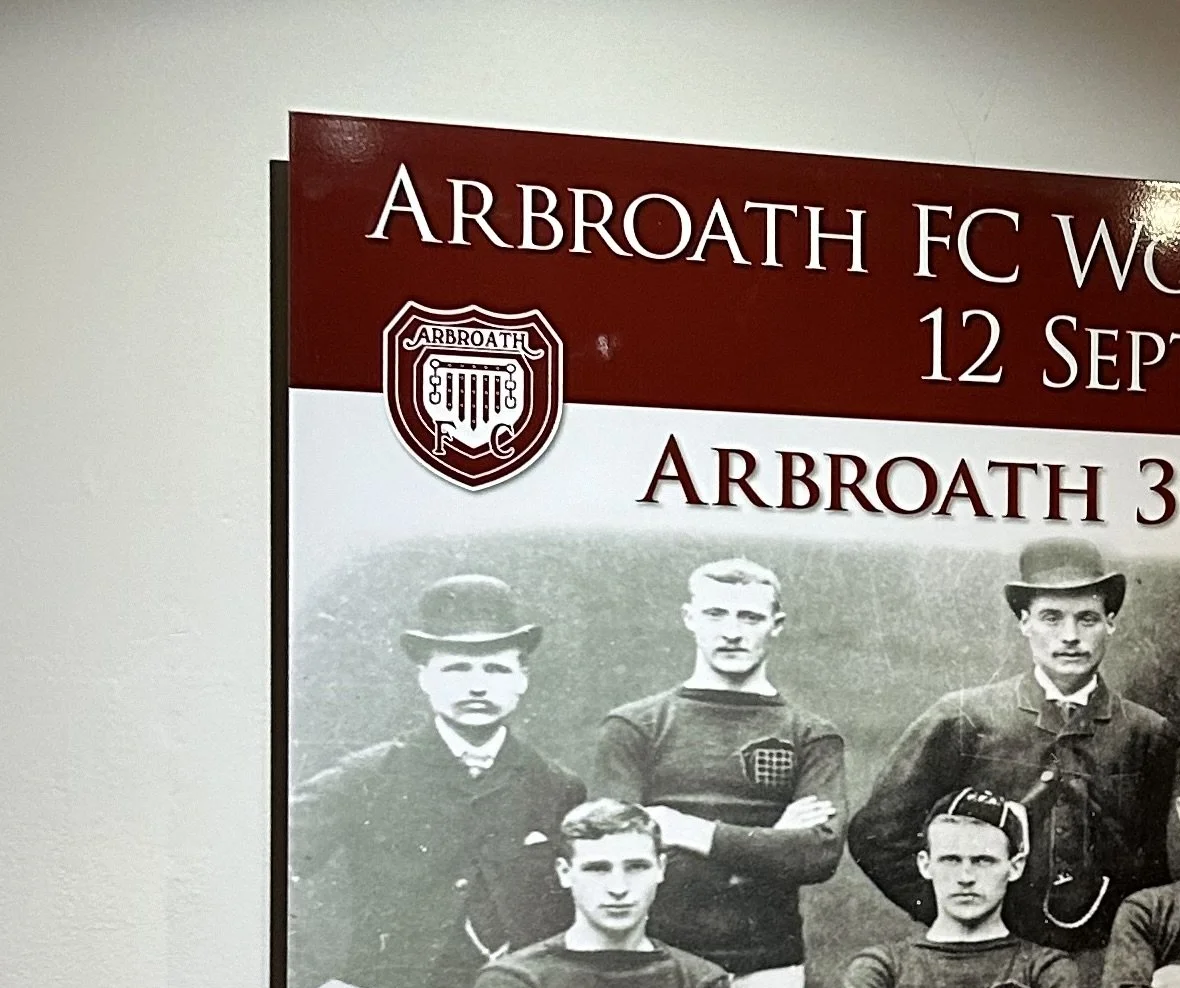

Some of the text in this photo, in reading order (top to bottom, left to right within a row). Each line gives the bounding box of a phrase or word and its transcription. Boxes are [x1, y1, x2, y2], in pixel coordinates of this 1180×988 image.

[365, 163, 868, 274] ARBROATH
[911, 203, 1020, 284] FC
[411, 327, 532, 353] ARBROATH
[919, 306, 1003, 384] 12
[635, 433, 1105, 523] ARBROATH
